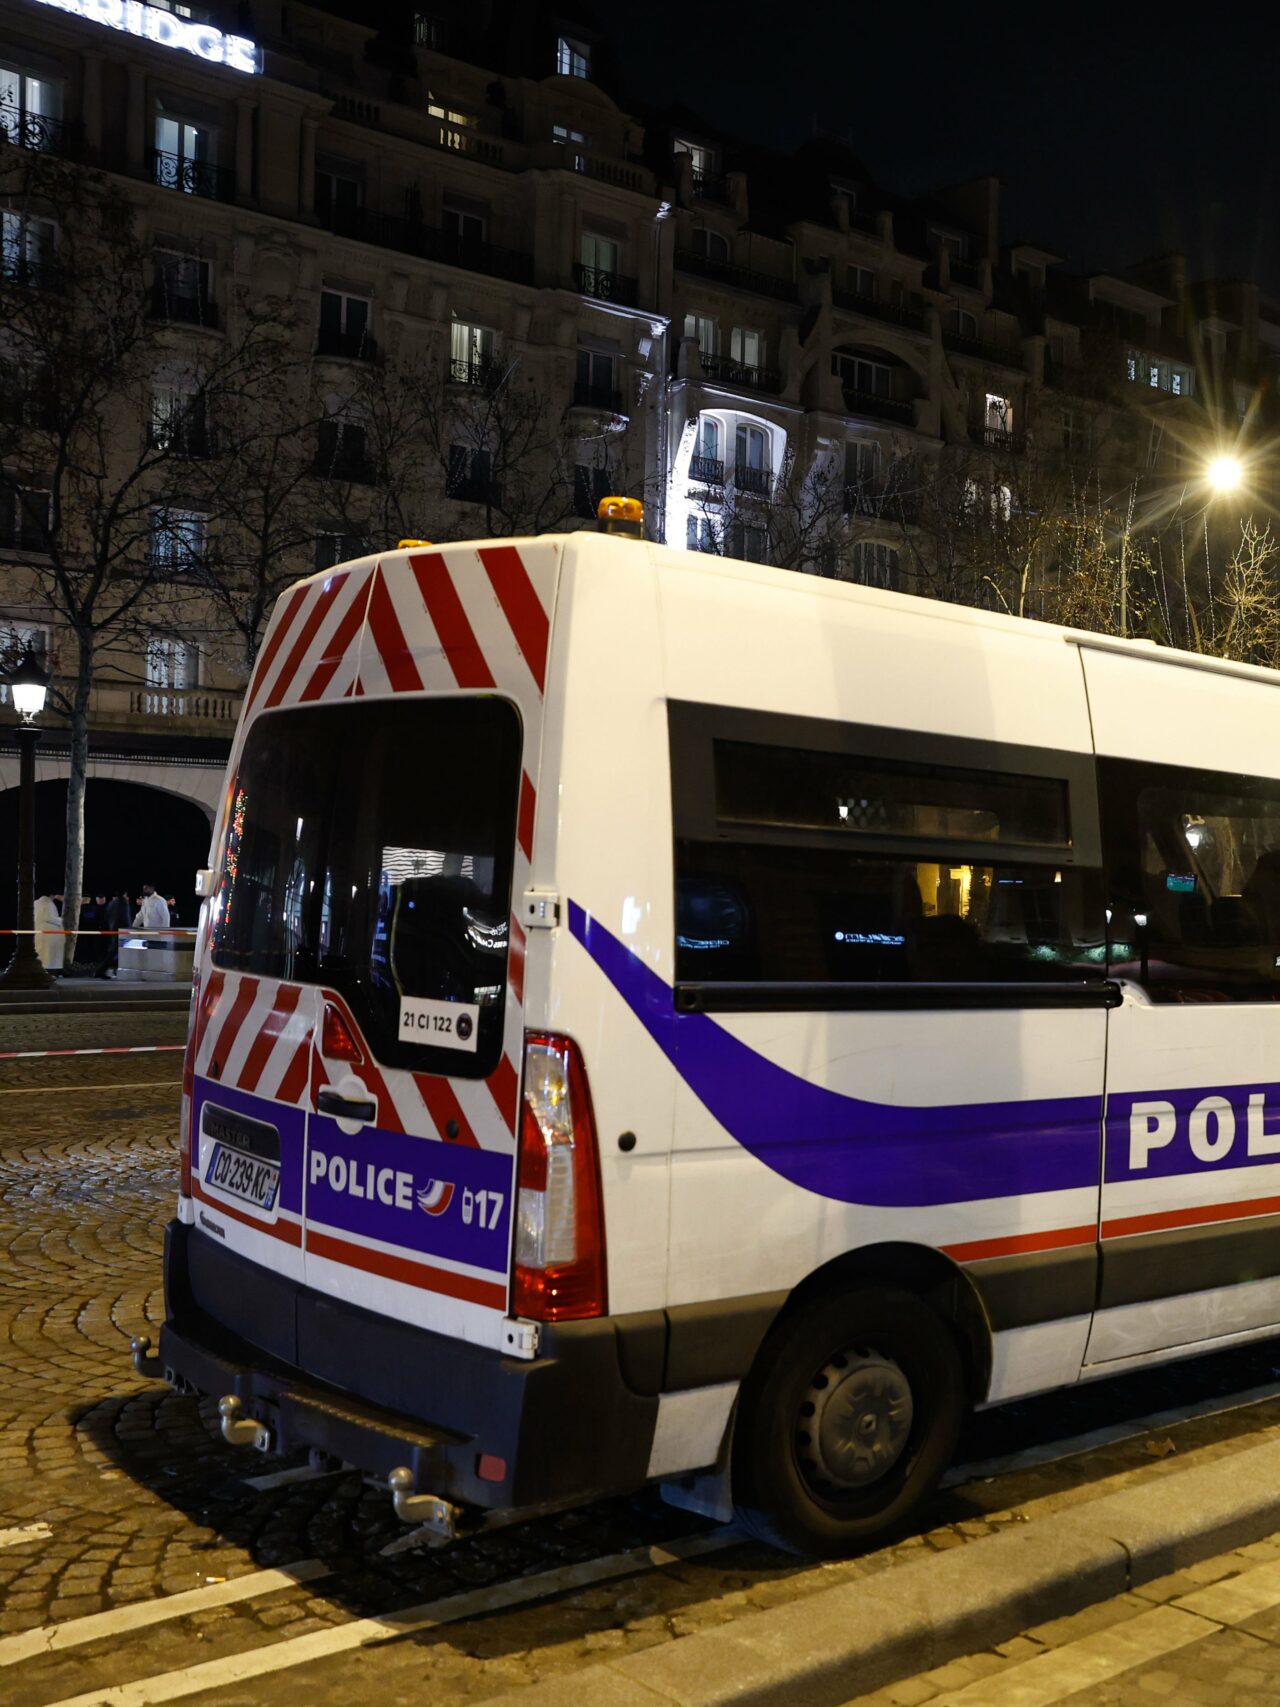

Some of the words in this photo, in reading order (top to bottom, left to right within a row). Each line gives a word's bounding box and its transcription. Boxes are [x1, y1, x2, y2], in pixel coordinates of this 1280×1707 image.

[403, 1011, 415, 1028] 21
[417, 1013, 430, 1030] CI
[433, 1015, 453, 1033] 122
[310, 1149, 414, 1212] POLICE
[474, 1189, 505, 1231] 17
